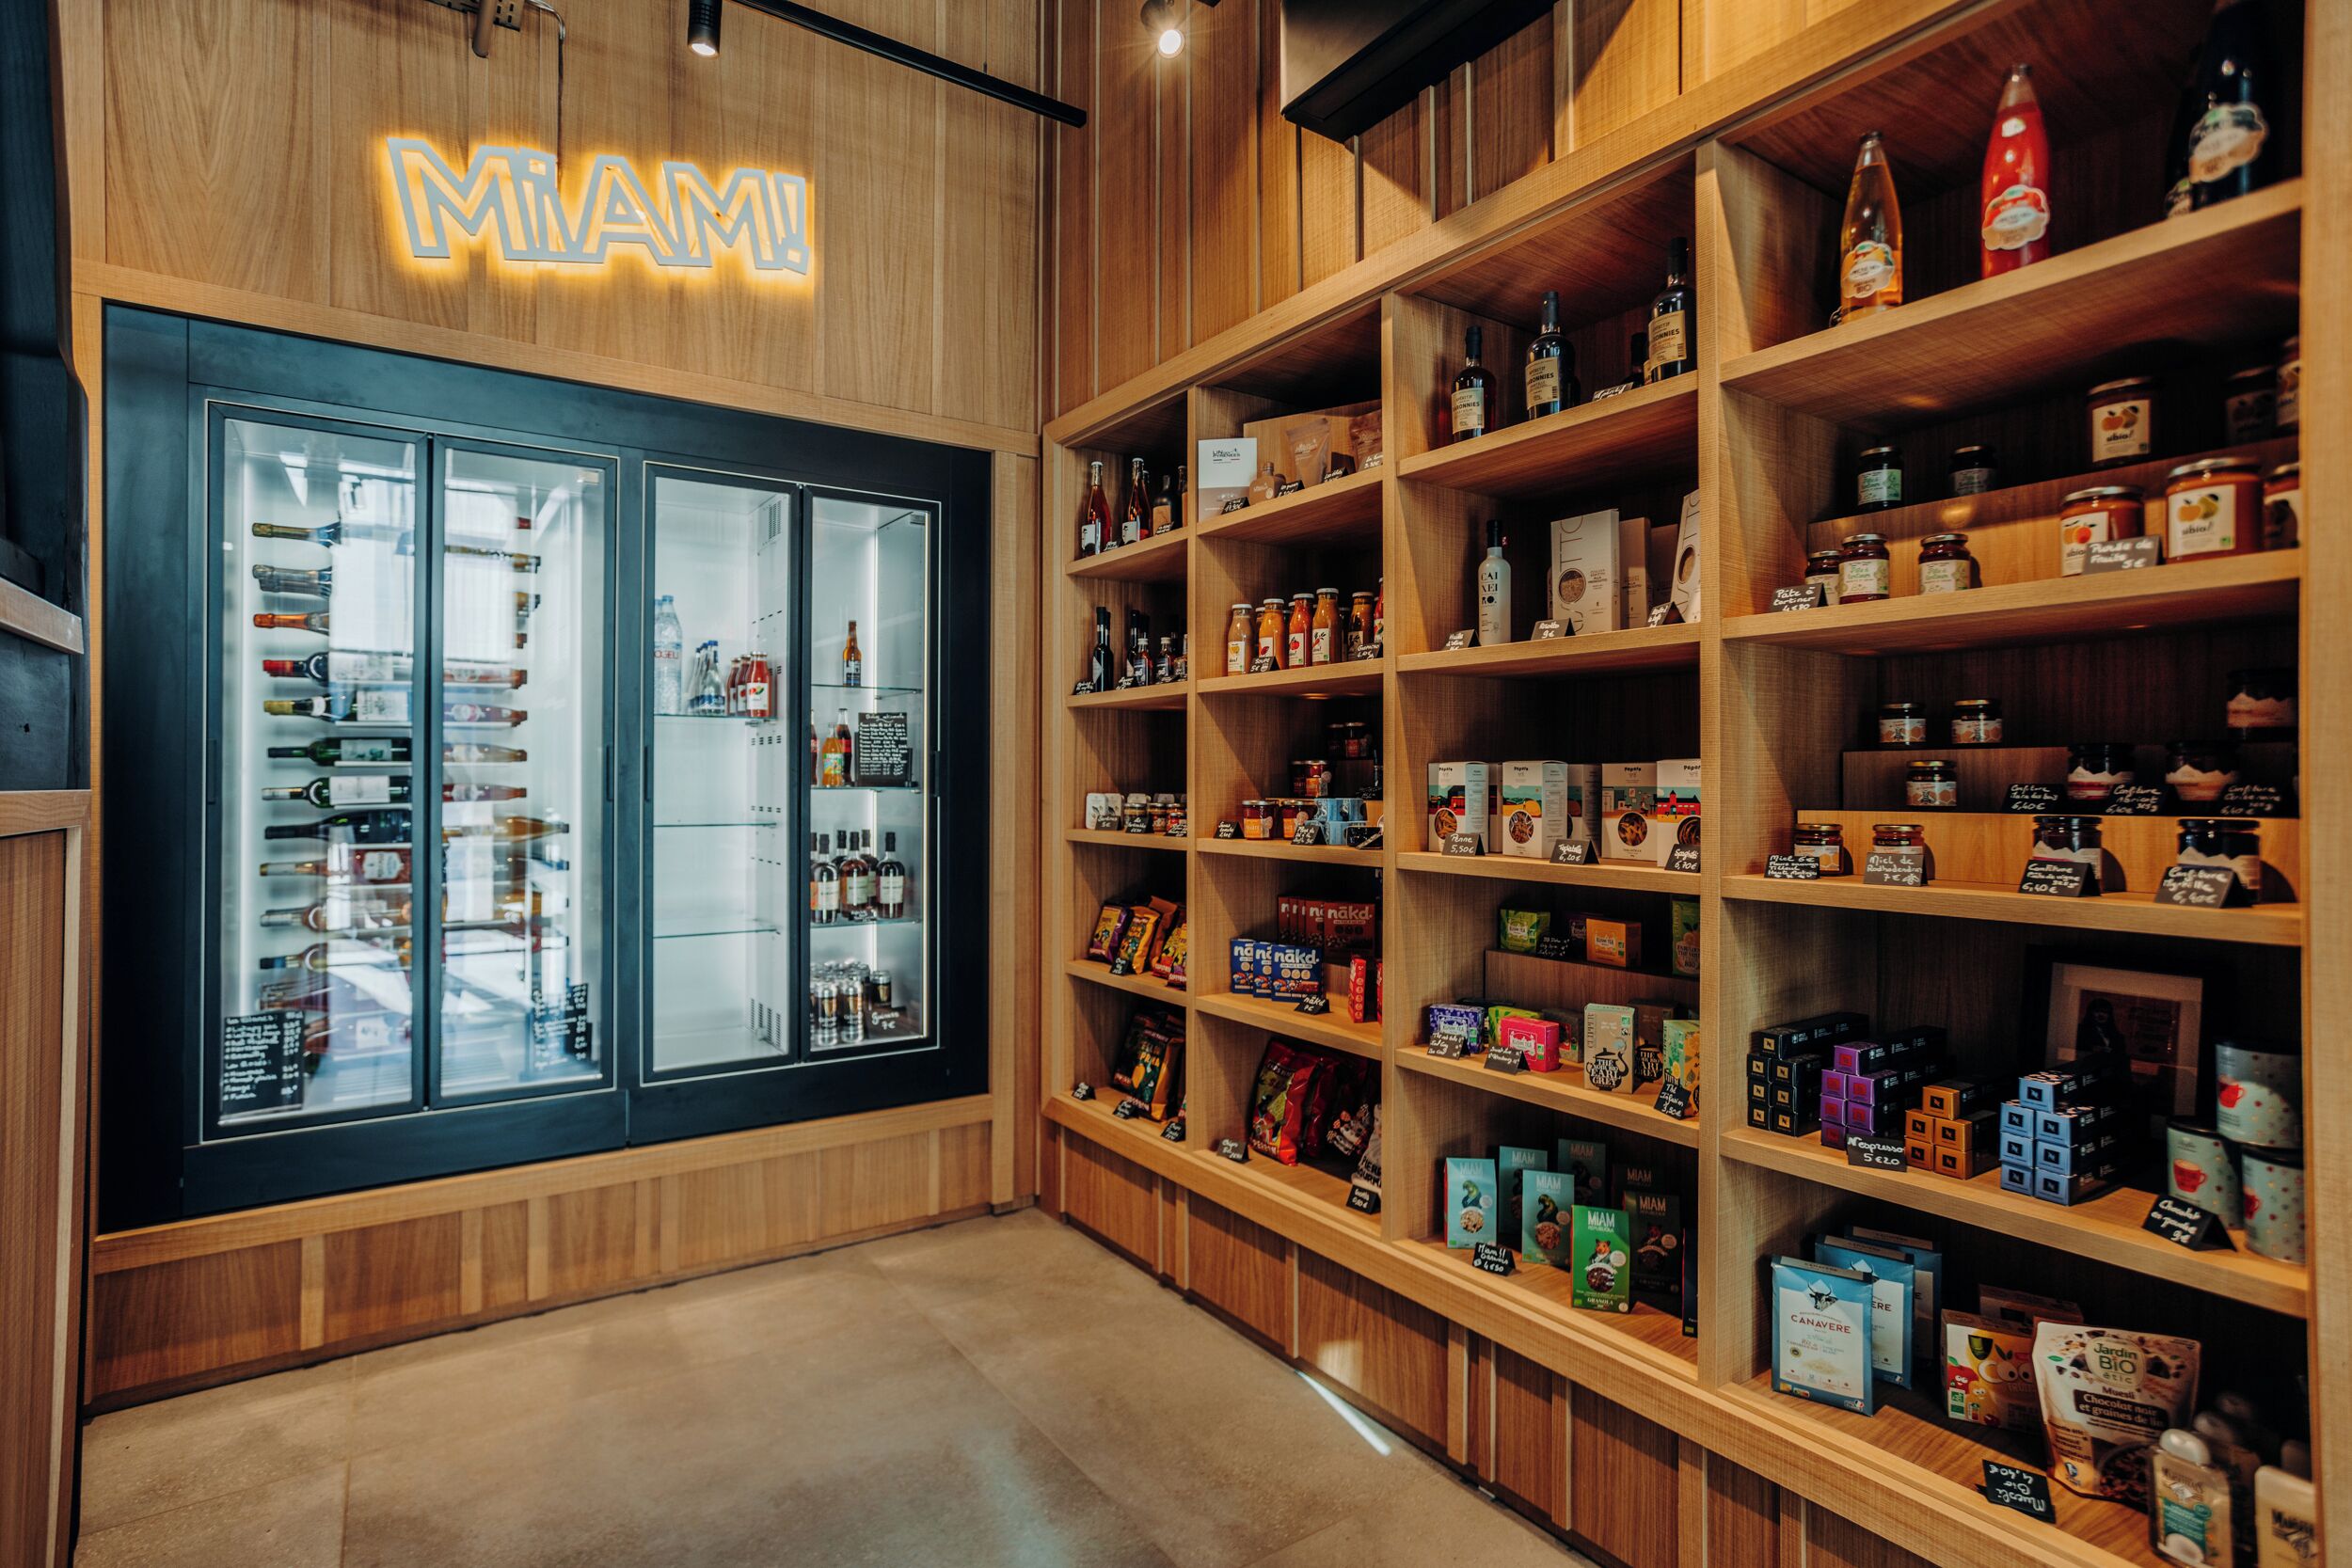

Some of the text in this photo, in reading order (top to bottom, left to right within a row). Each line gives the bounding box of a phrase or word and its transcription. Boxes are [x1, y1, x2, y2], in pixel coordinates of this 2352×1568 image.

[1773, 596, 1816, 606] tartiner
[2114, 784, 2162, 795] Confiture
[1869, 855, 1892, 864] Miel
[1591, 1069, 1621, 1080] EARL
[1847, 1136, 1906, 1153] Nespresso
[1790, 1314, 1851, 1334] CANAVERE
[2094, 1343, 2138, 1360] Jardin
[2102, 1386, 2136, 1400] Muesli
[2083, 1393, 2133, 1412] Chocolat
[2079, 1403, 2090, 1412] et
[2091, 1405, 2133, 1421] graines
[2134, 1413, 2148, 1423] de
